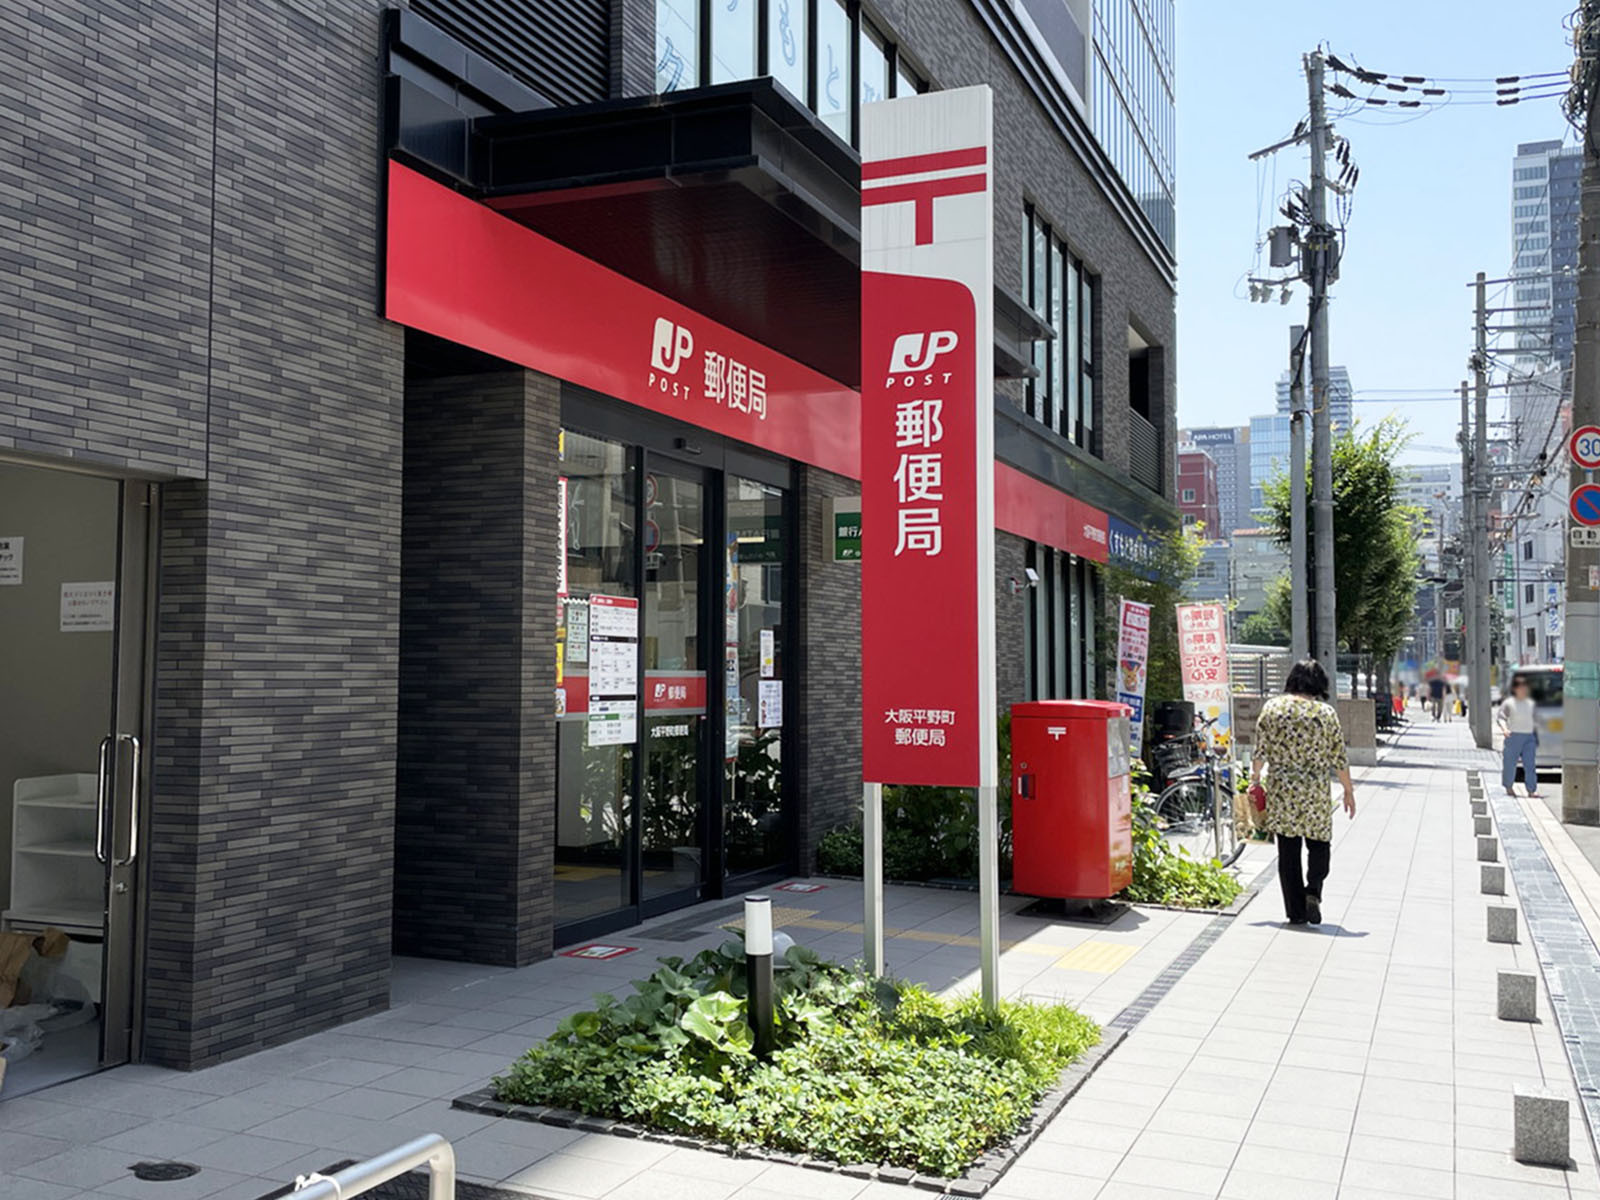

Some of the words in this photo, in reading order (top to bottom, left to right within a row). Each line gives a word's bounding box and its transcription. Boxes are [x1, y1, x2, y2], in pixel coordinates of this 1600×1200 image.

[651, 317, 694, 374] JP
[888, 330, 958, 373] JP
[648, 373, 690, 400] POST
[704, 350, 767, 420] 郵便局
[885, 373, 952, 388] POST
[1579, 438, 1600, 457] 30
[893, 399, 943, 557] 郵便局
[884, 708, 956, 725] 大阪平野町
[895, 728, 945, 747] 郵便局
